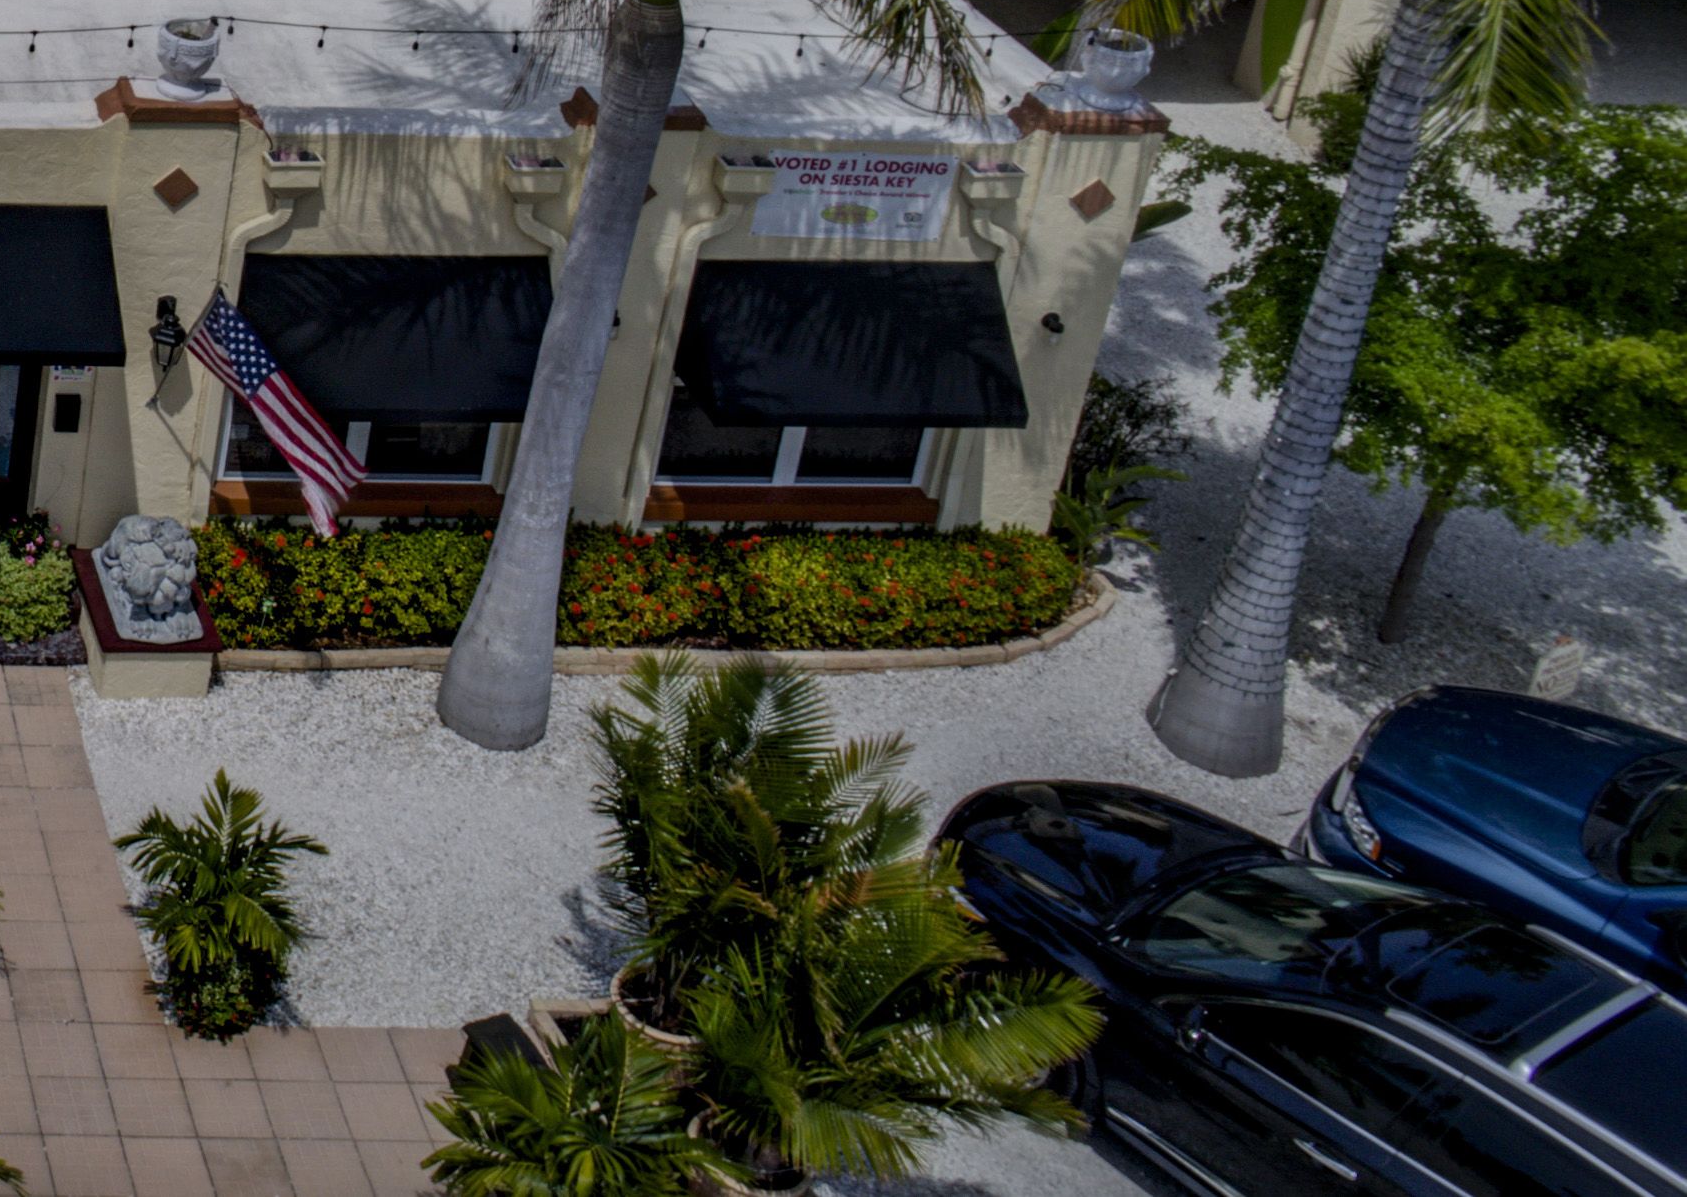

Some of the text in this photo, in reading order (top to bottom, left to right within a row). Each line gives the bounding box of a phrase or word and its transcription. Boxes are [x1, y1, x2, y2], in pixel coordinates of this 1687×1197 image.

[774, 156, 949, 176] VOTED #1 LODGING
[798, 173, 918, 189] ON SIESTA KEY
